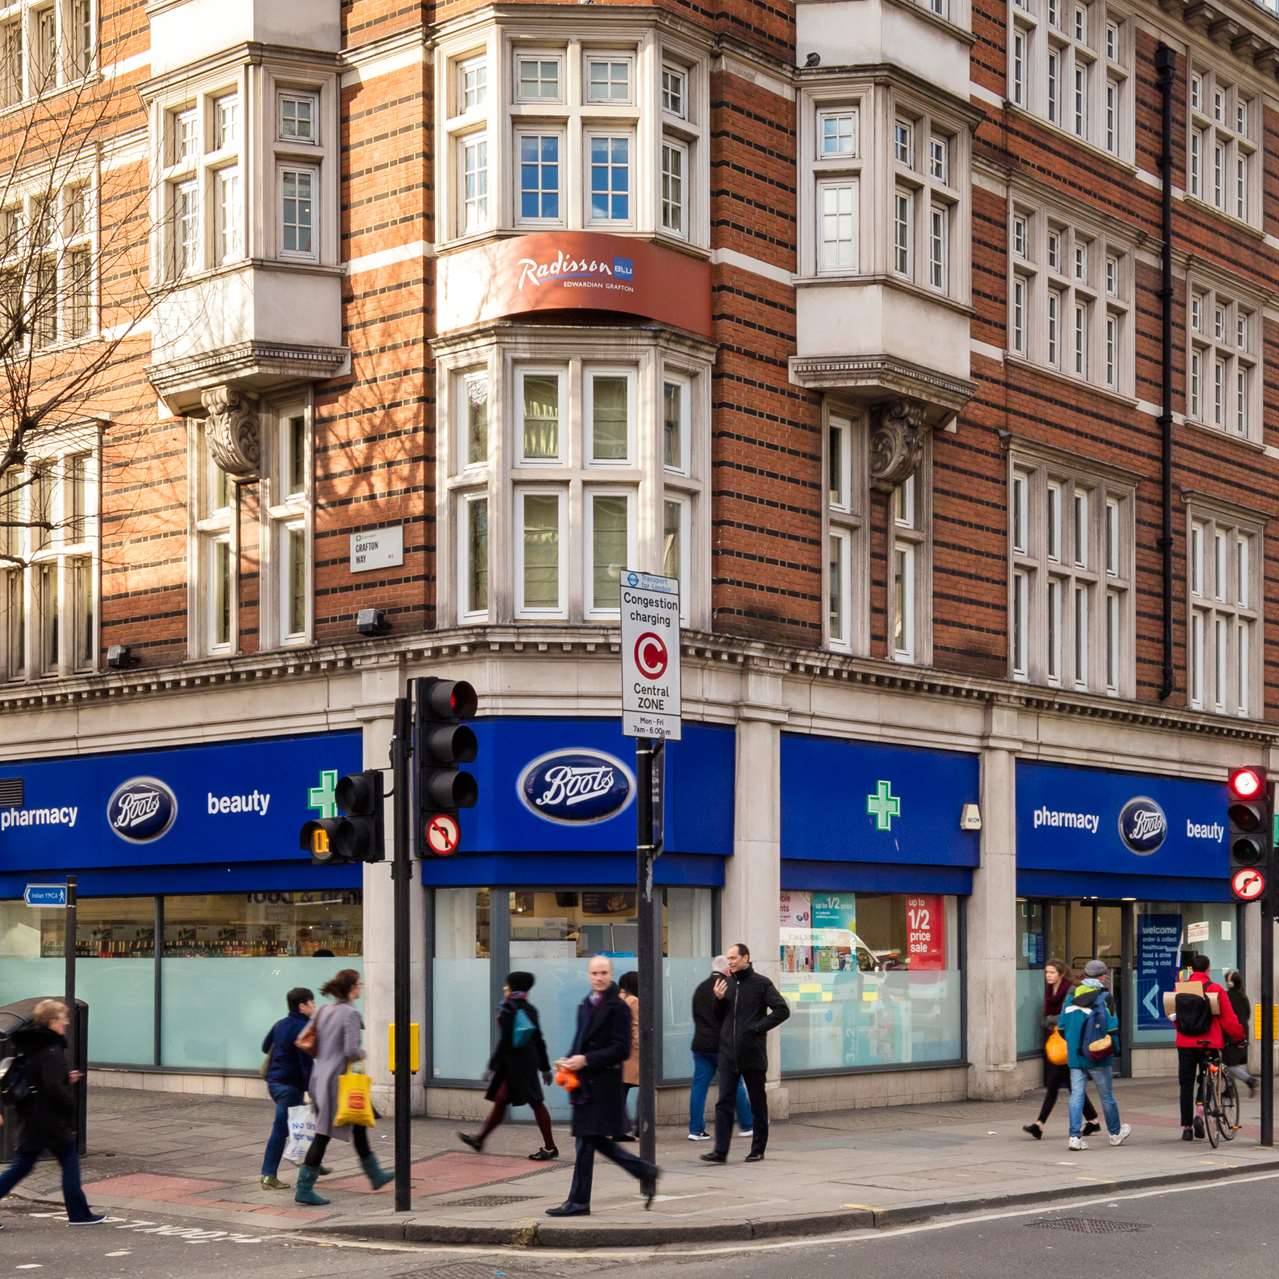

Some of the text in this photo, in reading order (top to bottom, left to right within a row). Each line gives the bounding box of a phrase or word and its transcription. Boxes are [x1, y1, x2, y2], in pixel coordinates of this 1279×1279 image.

[518, 250, 612, 288] Radisson
[614, 264, 632, 274] BLU
[606, 284, 634, 293] GRAFTON
[624, 592, 678, 610] Congestion
[630, 610, 670, 628] charging
[634, 682, 670, 697] Central
[638, 698, 664, 710] ZONE
[634, 725, 646, 734] 7am
[640, 716, 652, 725] Mon
[536, 766, 614, 806] Boots
[114, 791, 160, 828] Boots
[208, 790, 270, 816] beauty
[1, 806, 78, 831] pharmacy
[1034, 805, 1099, 834] pharmacy
[1130, 809, 1166, 841] Boots
[1186, 819, 1224, 843] beauty
[908, 900, 918, 908] up
[908, 909, 930, 930] 1/2
[910, 931, 930, 944] price
[910, 942, 928, 952] sale
